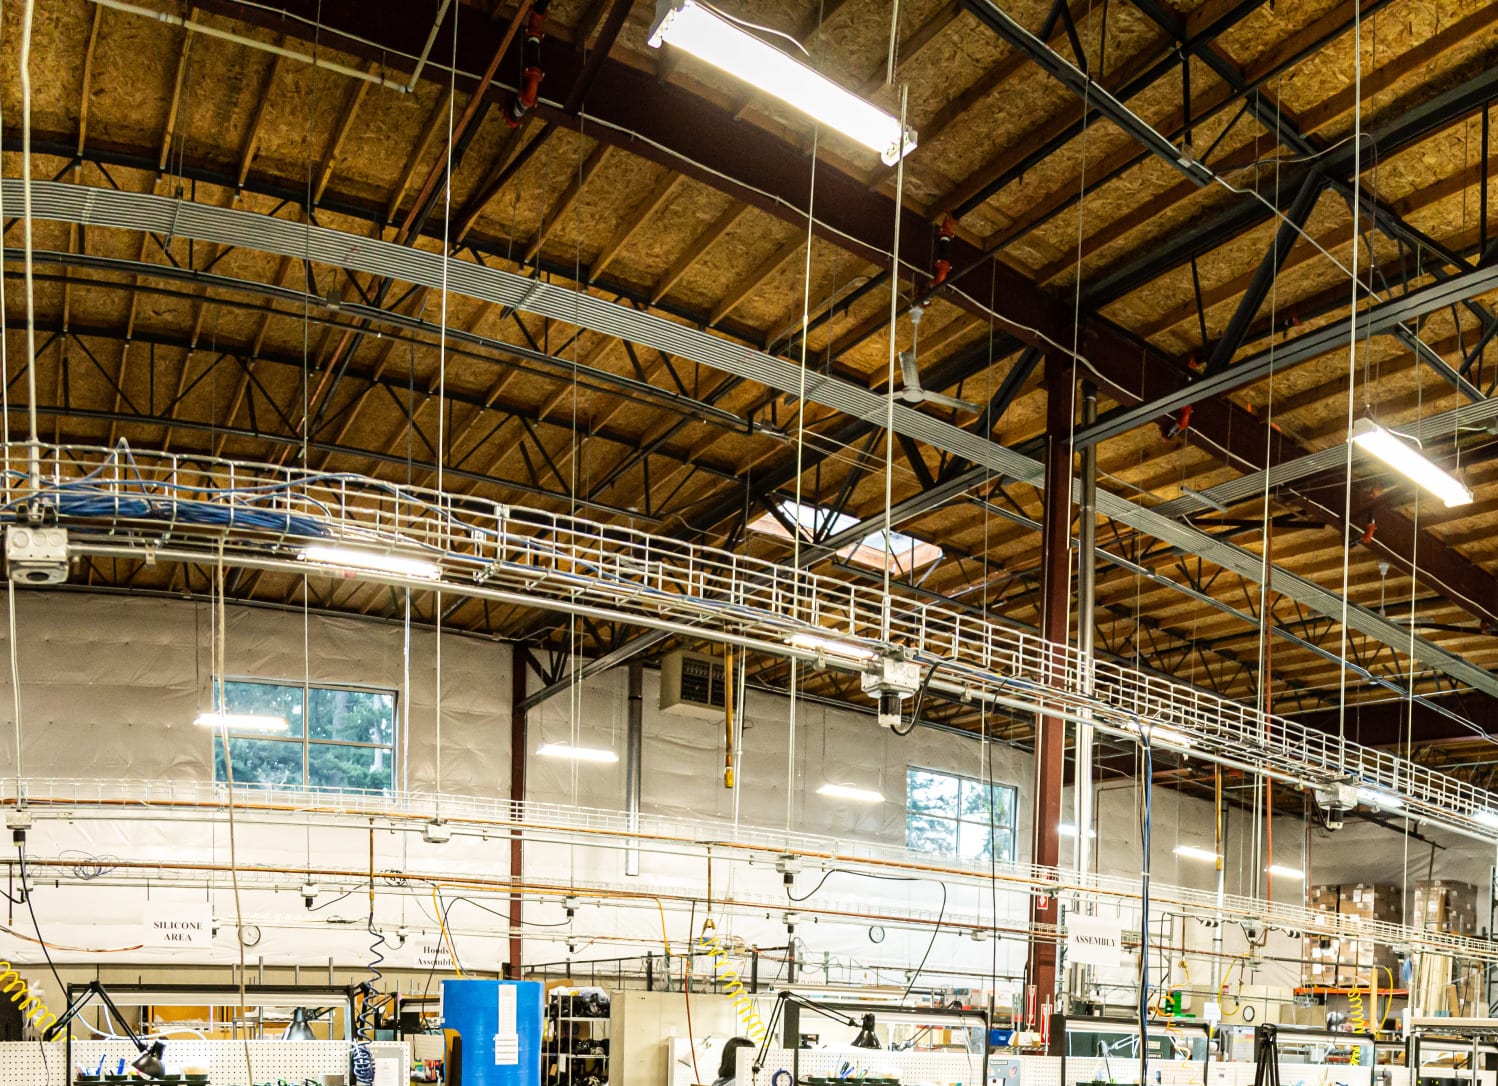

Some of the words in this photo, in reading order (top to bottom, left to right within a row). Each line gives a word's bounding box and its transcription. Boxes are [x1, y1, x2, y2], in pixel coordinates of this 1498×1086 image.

[153, 921, 203, 930] SILICONE
[164, 933, 192, 942] AREA
[1075, 935, 1117, 948] ASSEMBLY
